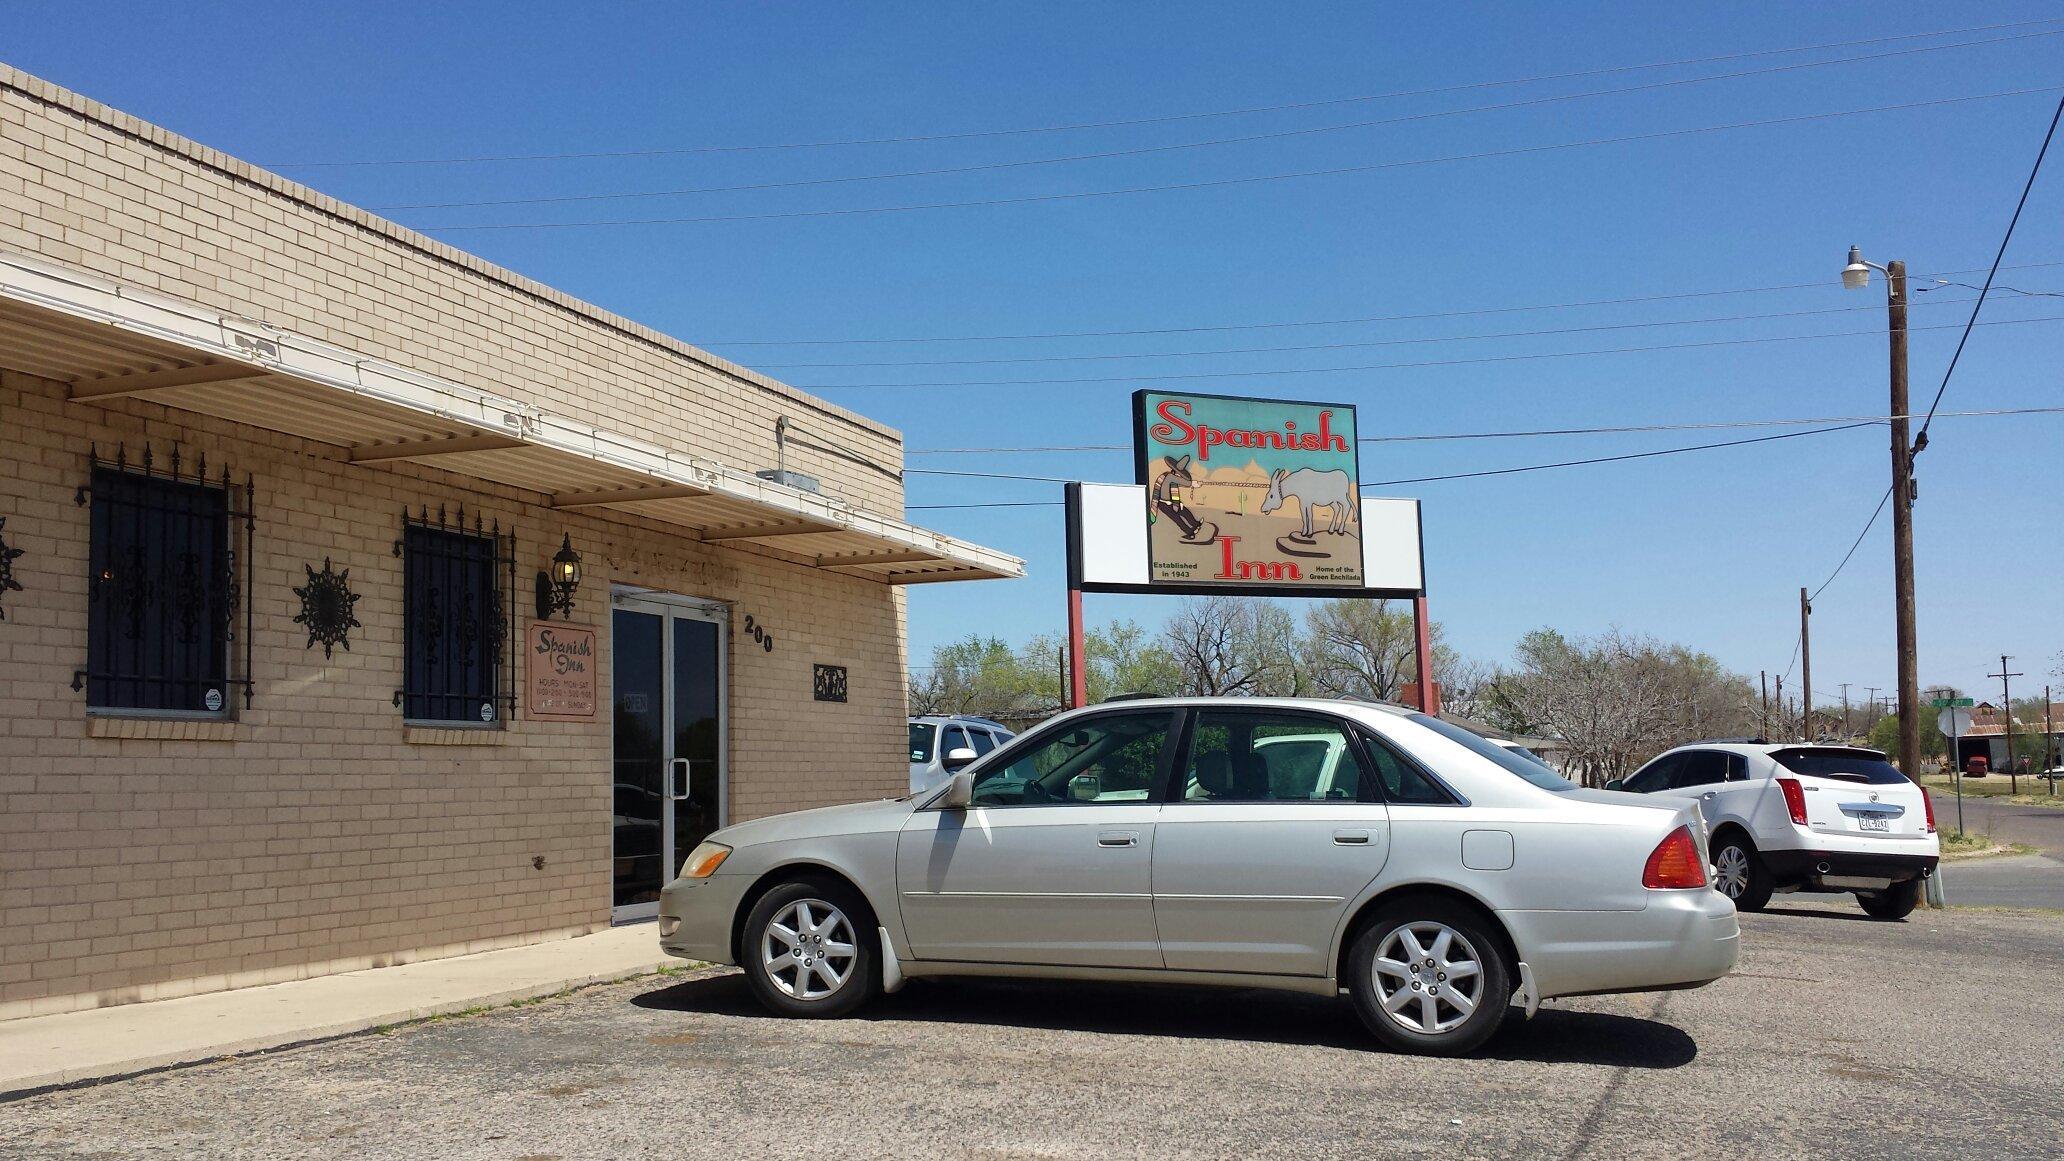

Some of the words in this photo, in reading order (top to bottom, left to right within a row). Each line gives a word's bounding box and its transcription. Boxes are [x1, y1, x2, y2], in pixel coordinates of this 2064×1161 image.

[1151, 400, 1350, 461] Spanish
[1153, 561, 1198, 570] Established
[1214, 535, 1303, 580] Inn
[535, 630, 592, 669] Spanish
[744, 615, 773, 652] 200
[555, 654, 586, 675] Inn
